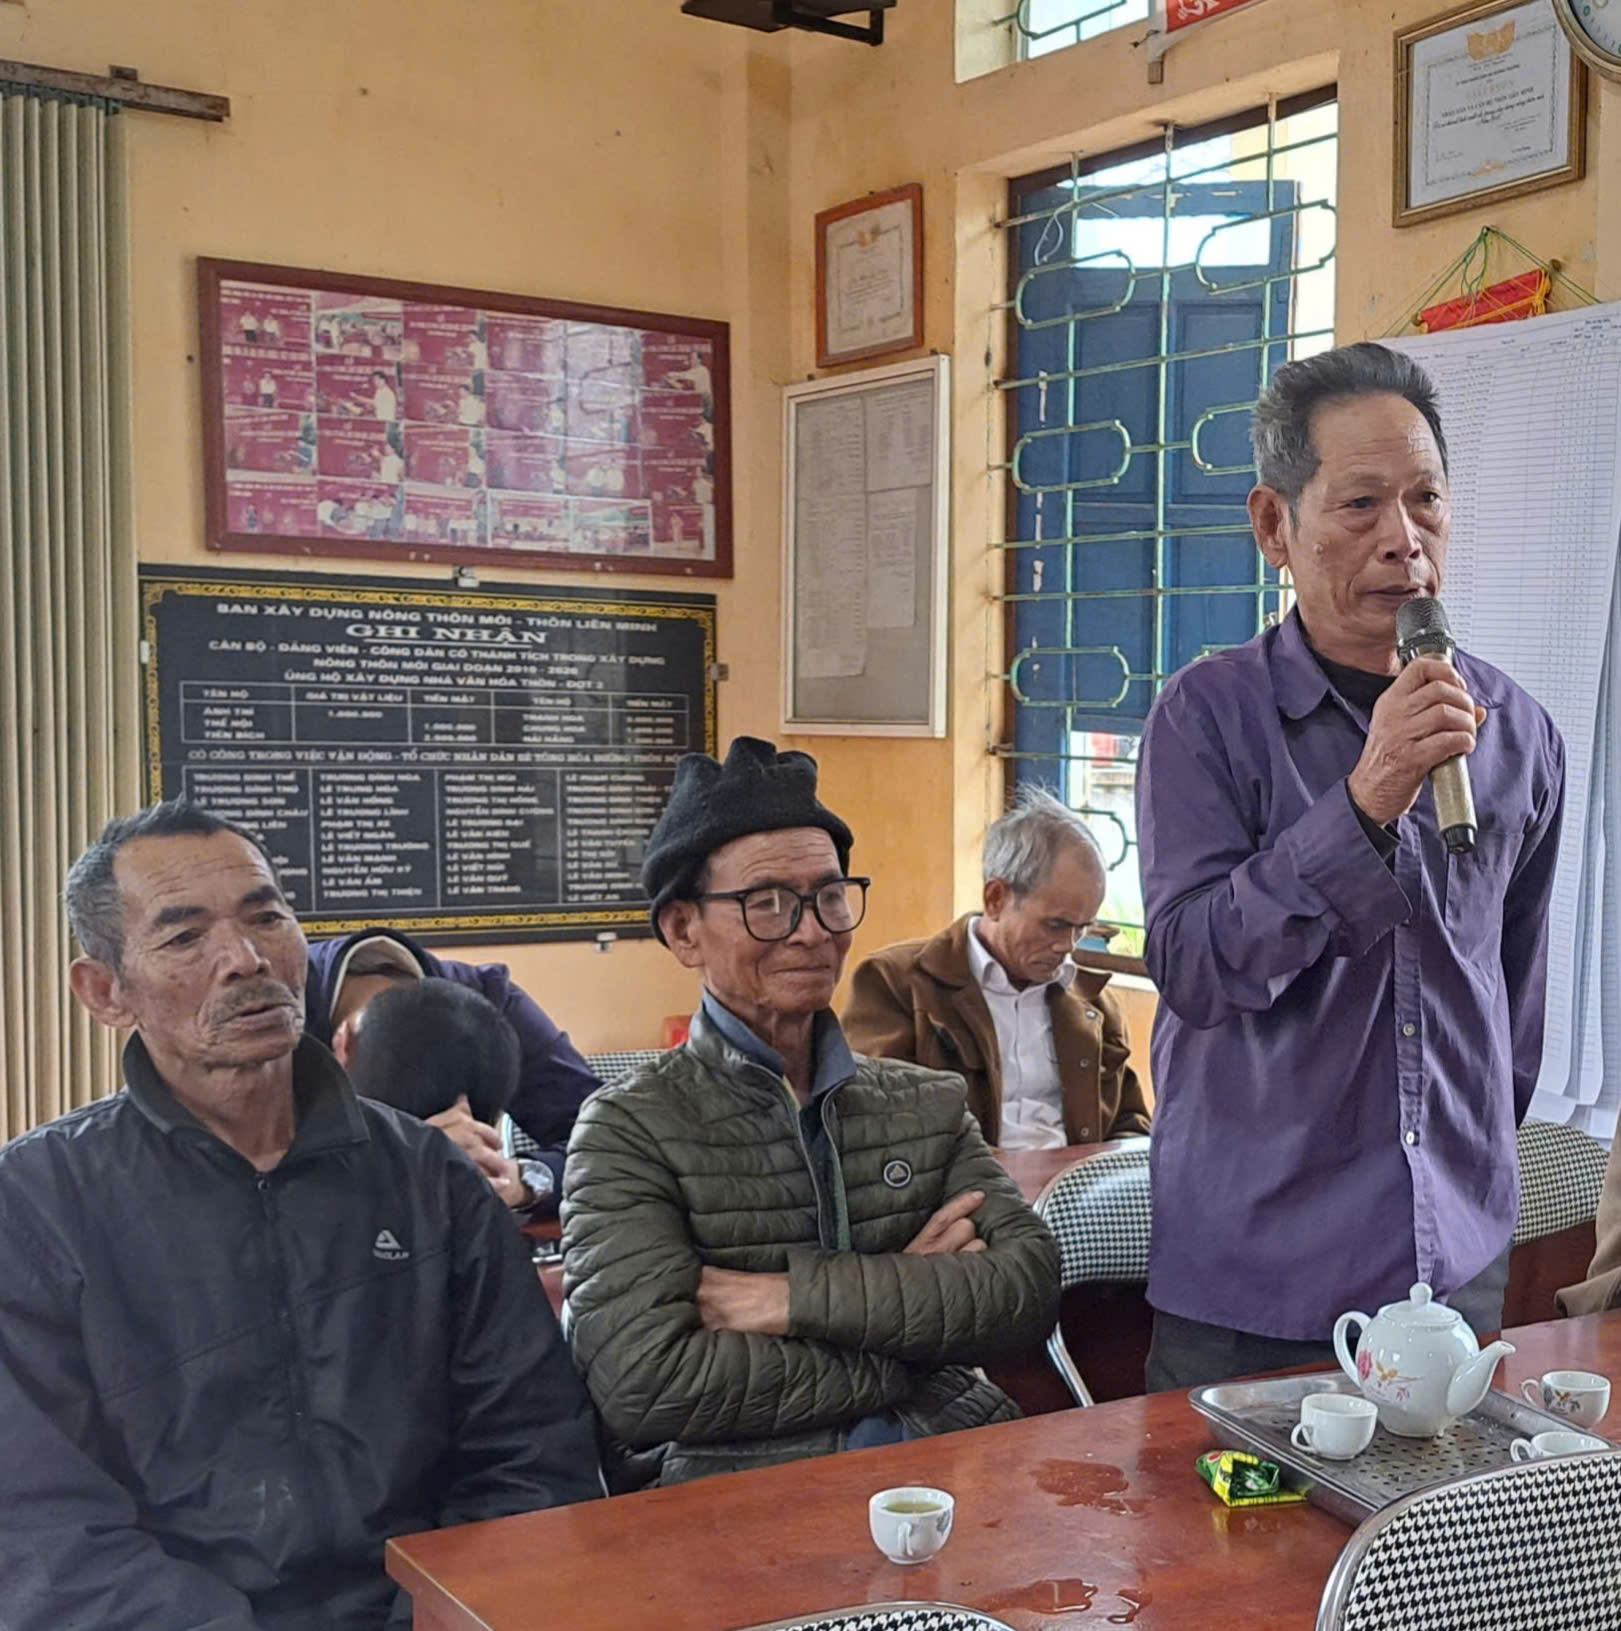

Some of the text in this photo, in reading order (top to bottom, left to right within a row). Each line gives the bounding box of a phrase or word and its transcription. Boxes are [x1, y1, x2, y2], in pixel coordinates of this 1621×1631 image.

[217, 603, 257, 614] BAN
[263, 604, 304, 617] XÂY
[368, 607, 421, 622] NÔNG
[426, 611, 474, 624] THÔN
[526, 616, 572, 628] THÔN
[576, 617, 612, 630] LIÊN
[615, 621, 657, 632] MINH
[346, 623, 548, 645] GHI NHẬN
[313, 657, 356, 668] NÔNG
[359, 658, 399, 669] THÔN
